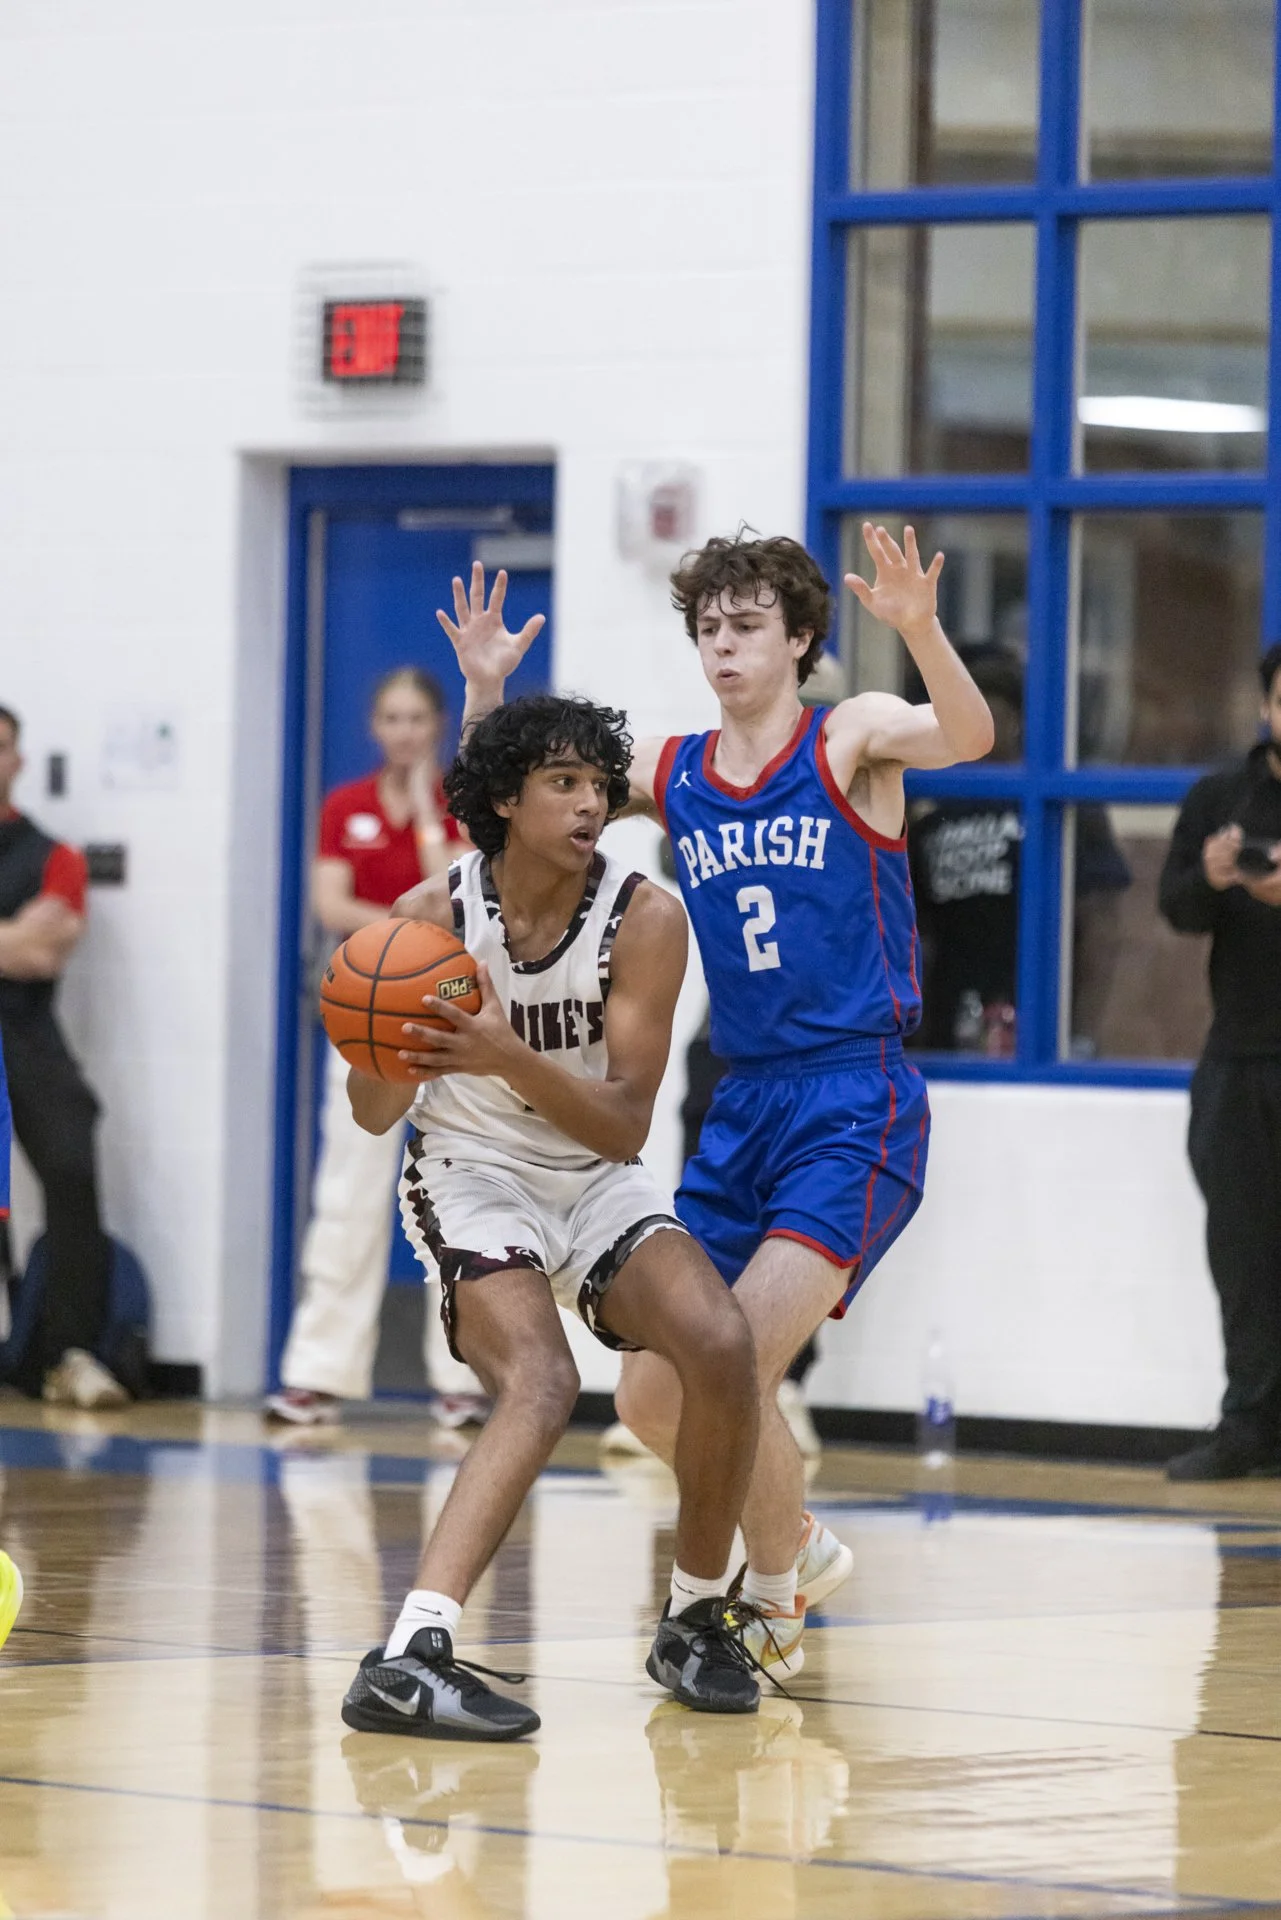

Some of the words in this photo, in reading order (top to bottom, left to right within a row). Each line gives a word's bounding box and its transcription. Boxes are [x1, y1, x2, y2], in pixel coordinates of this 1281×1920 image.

[678, 815, 831, 889] PARISH
[736, 885, 781, 972] 2
[440, 978, 467, 998] PRO
